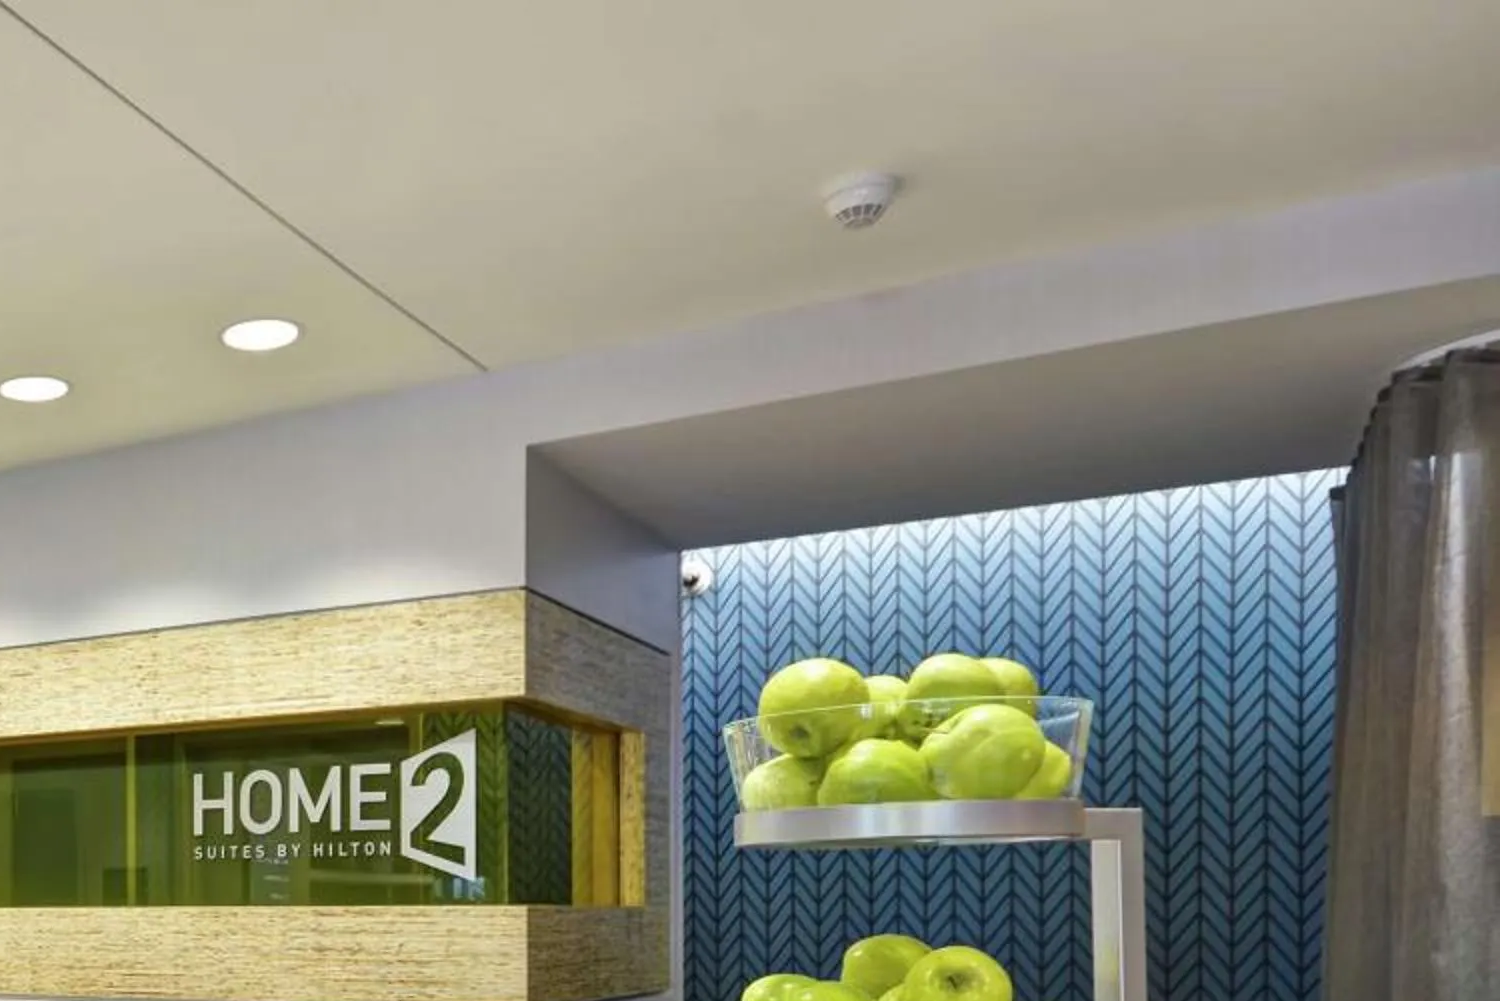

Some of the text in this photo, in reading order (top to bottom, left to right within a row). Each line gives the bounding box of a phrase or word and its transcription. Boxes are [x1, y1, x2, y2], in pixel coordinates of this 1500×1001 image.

[193, 840, 392, 860] SUITES BY HILTON
